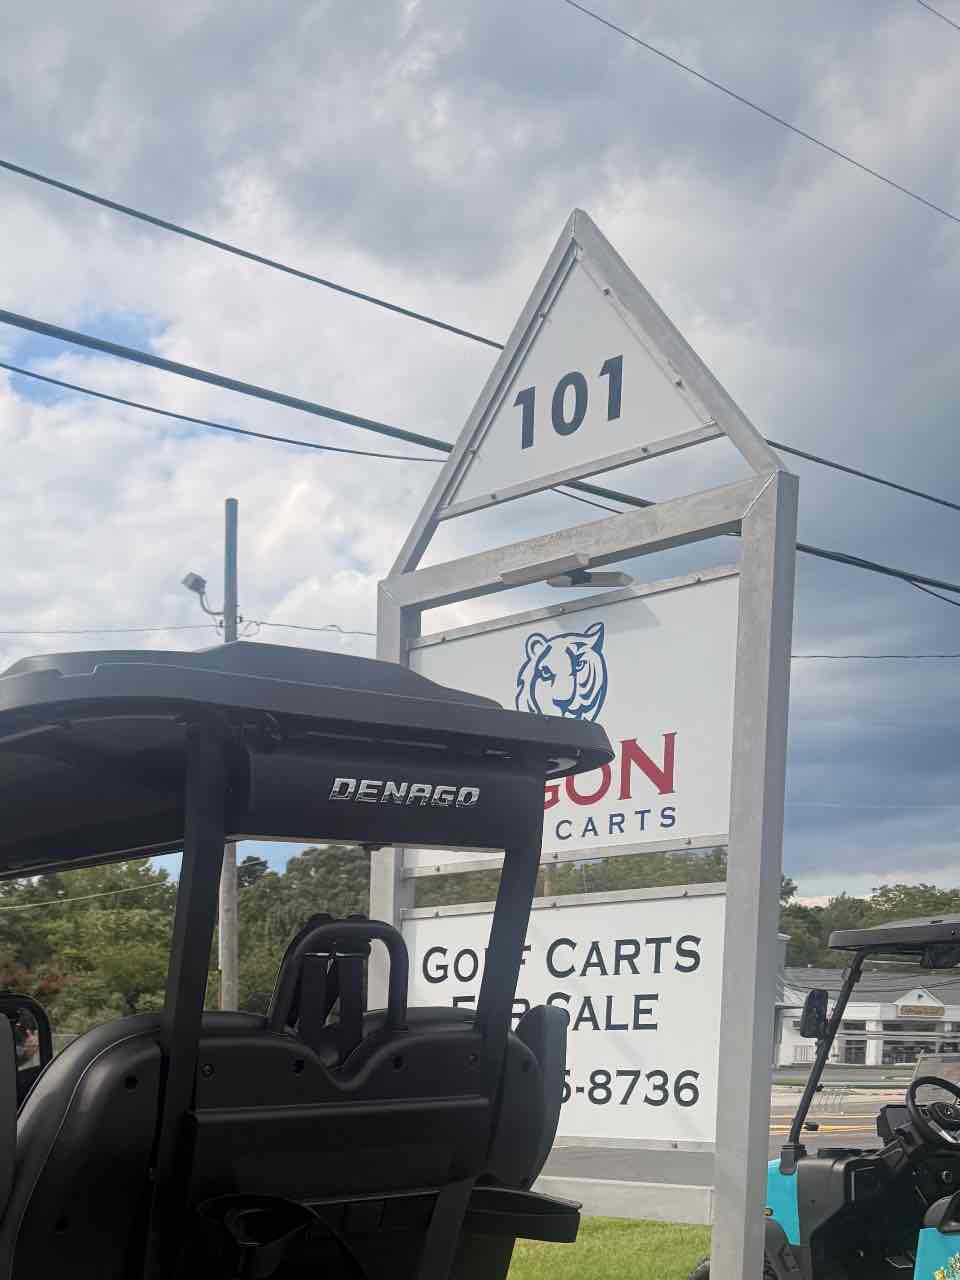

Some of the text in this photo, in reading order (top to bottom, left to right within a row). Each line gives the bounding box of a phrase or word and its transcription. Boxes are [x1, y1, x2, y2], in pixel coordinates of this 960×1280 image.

[513, 355, 623, 450] 101
[329, 778, 480, 808] DENAGO
[555, 806, 676, 840] CARTS
[546, 934, 701, 978] CARTS
